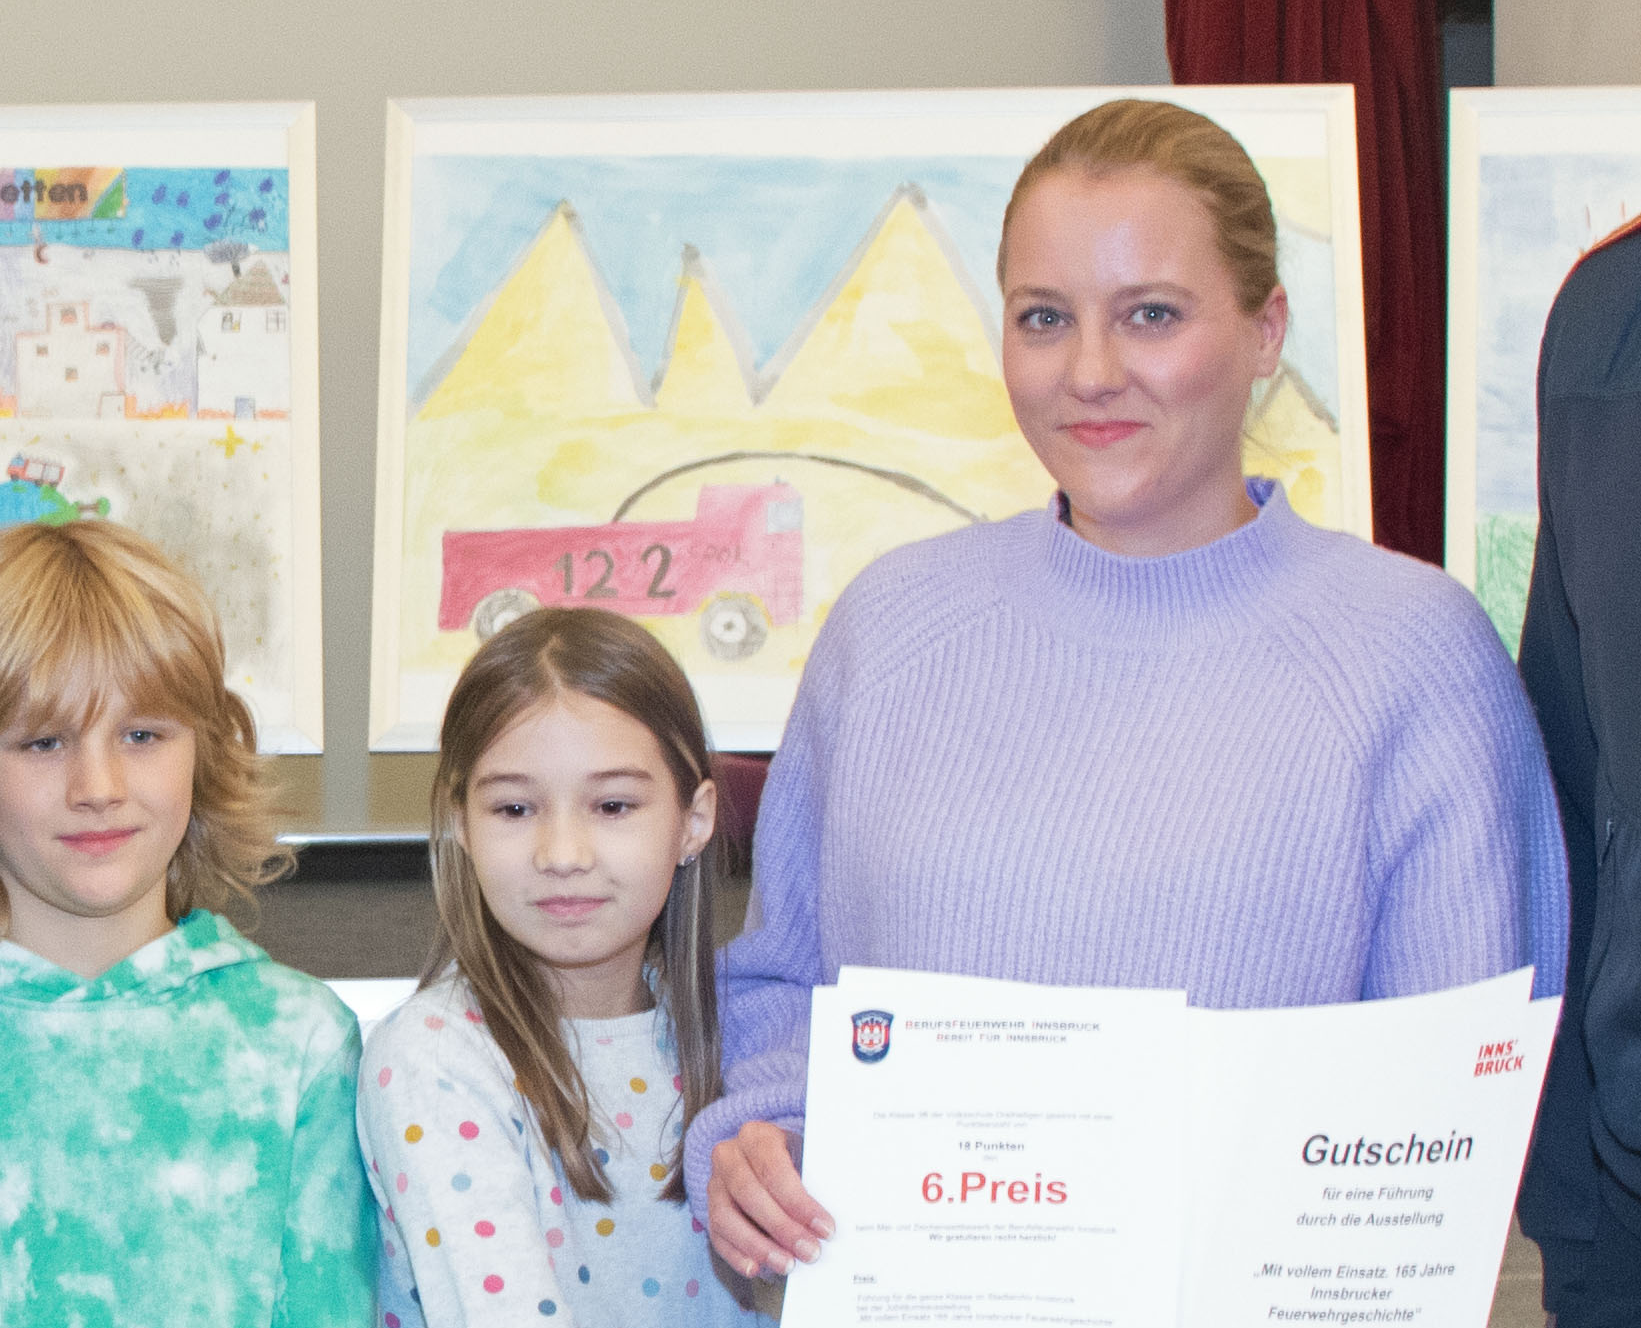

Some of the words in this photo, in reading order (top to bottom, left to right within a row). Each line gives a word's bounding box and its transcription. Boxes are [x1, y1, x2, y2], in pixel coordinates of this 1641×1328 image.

[905, 1019, 1026, 1030] BERUFSFEUERWEHR
[1031, 1021, 1101, 1032] INNSBRUCK
[936, 1033, 973, 1043] BEREIT
[979, 1033, 1001, 1043] FÜR
[1006, 1034, 1068, 1044] INNSBRUCK
[1472, 1054, 1526, 1078] BRUCK
[975, 1141, 1025, 1152] Punkten
[1301, 1129, 1474, 1167] Gutschein
[921, 1171, 1069, 1204] 6.Preis
[1321, 1186, 1342, 1201] für
[1345, 1187, 1374, 1201] eine
[1377, 1185, 1434, 1202] Führung
[1296, 1212, 1337, 1227] durch
[1340, 1212, 1361, 1227] die
[1364, 1211, 1444, 1228] Ausstellung
[1286, 1264, 1332, 1279] vollem
[1394, 1264, 1417, 1279] 165
[1420, 1262, 1456, 1278] Jahre
[1310, 1286, 1394, 1301] Innsbrucker
